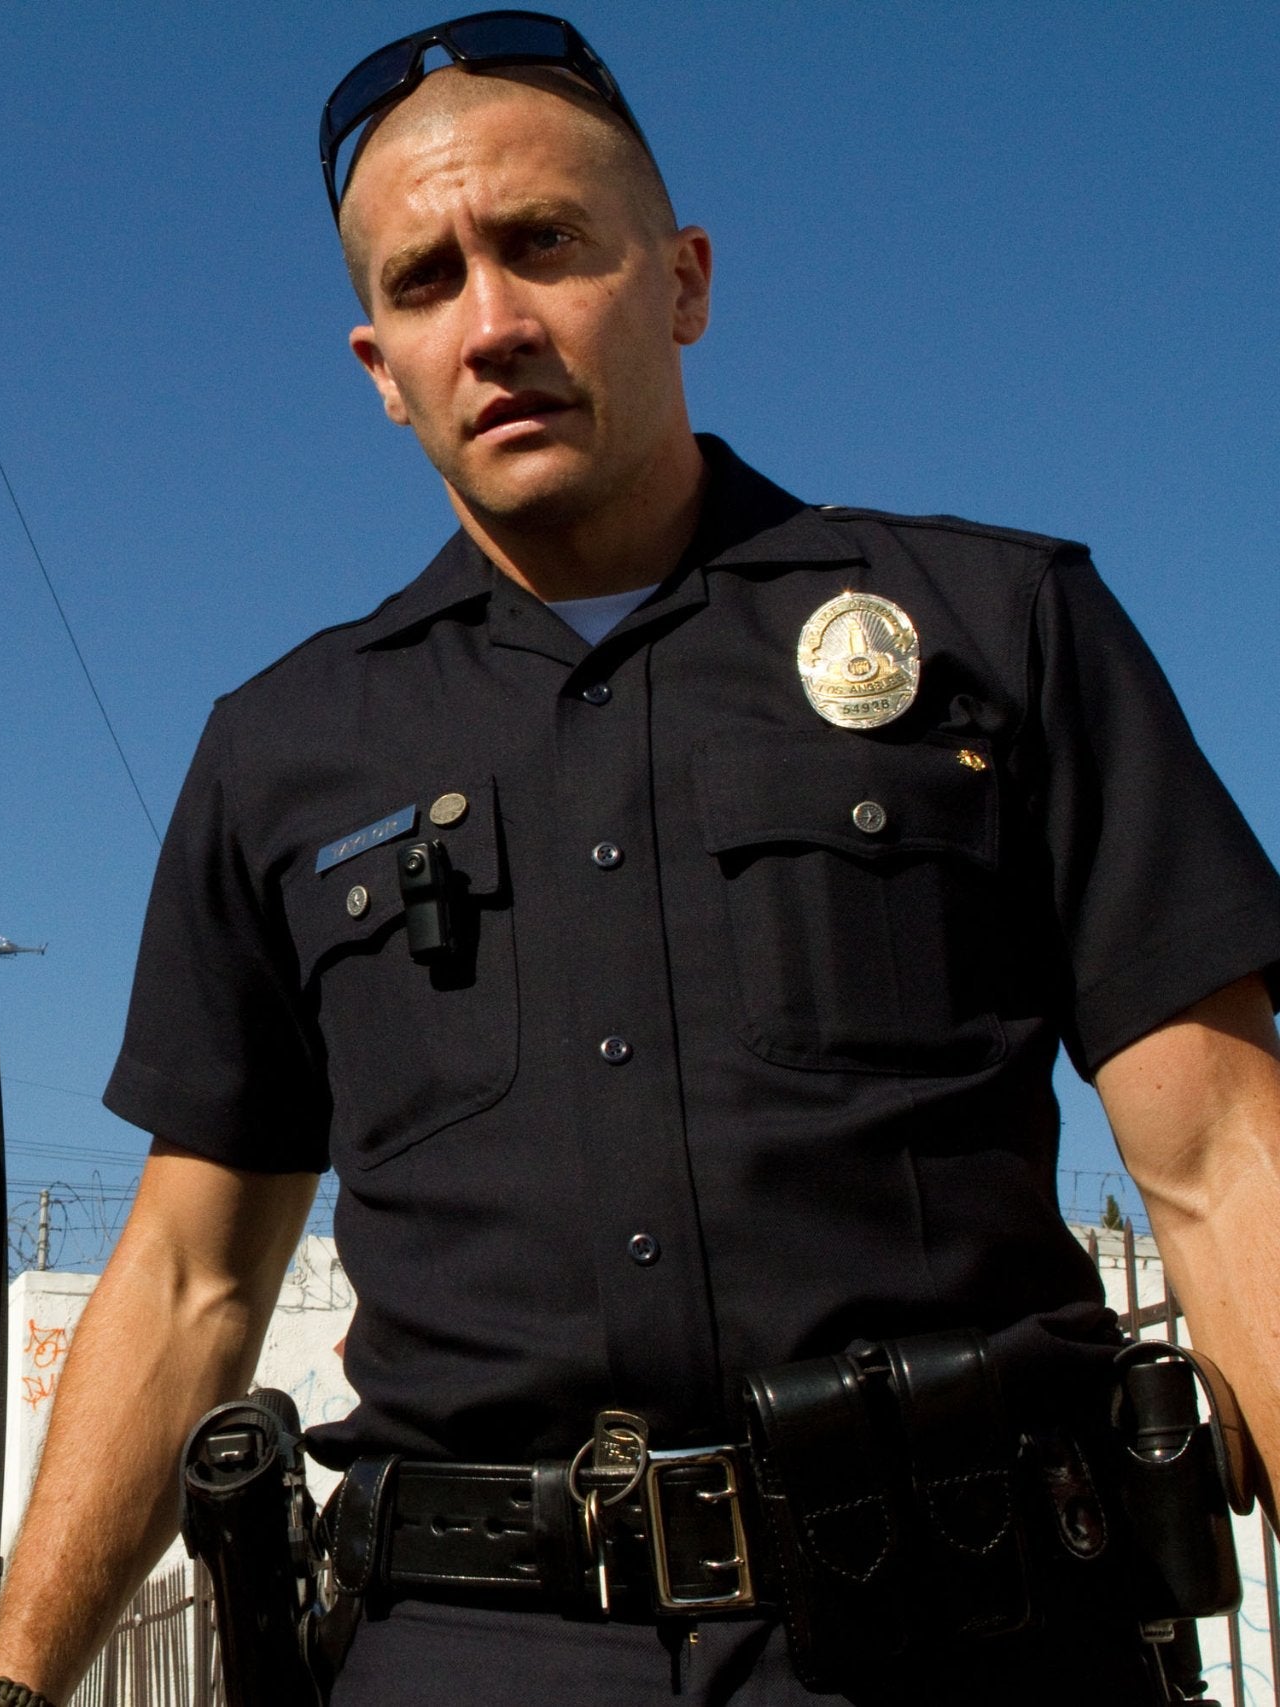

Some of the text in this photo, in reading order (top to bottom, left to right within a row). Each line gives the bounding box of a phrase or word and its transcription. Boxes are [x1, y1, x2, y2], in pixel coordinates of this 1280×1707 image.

[818, 673, 905, 695] LOS ANGELES
[843, 699, 890, 715] 54928
